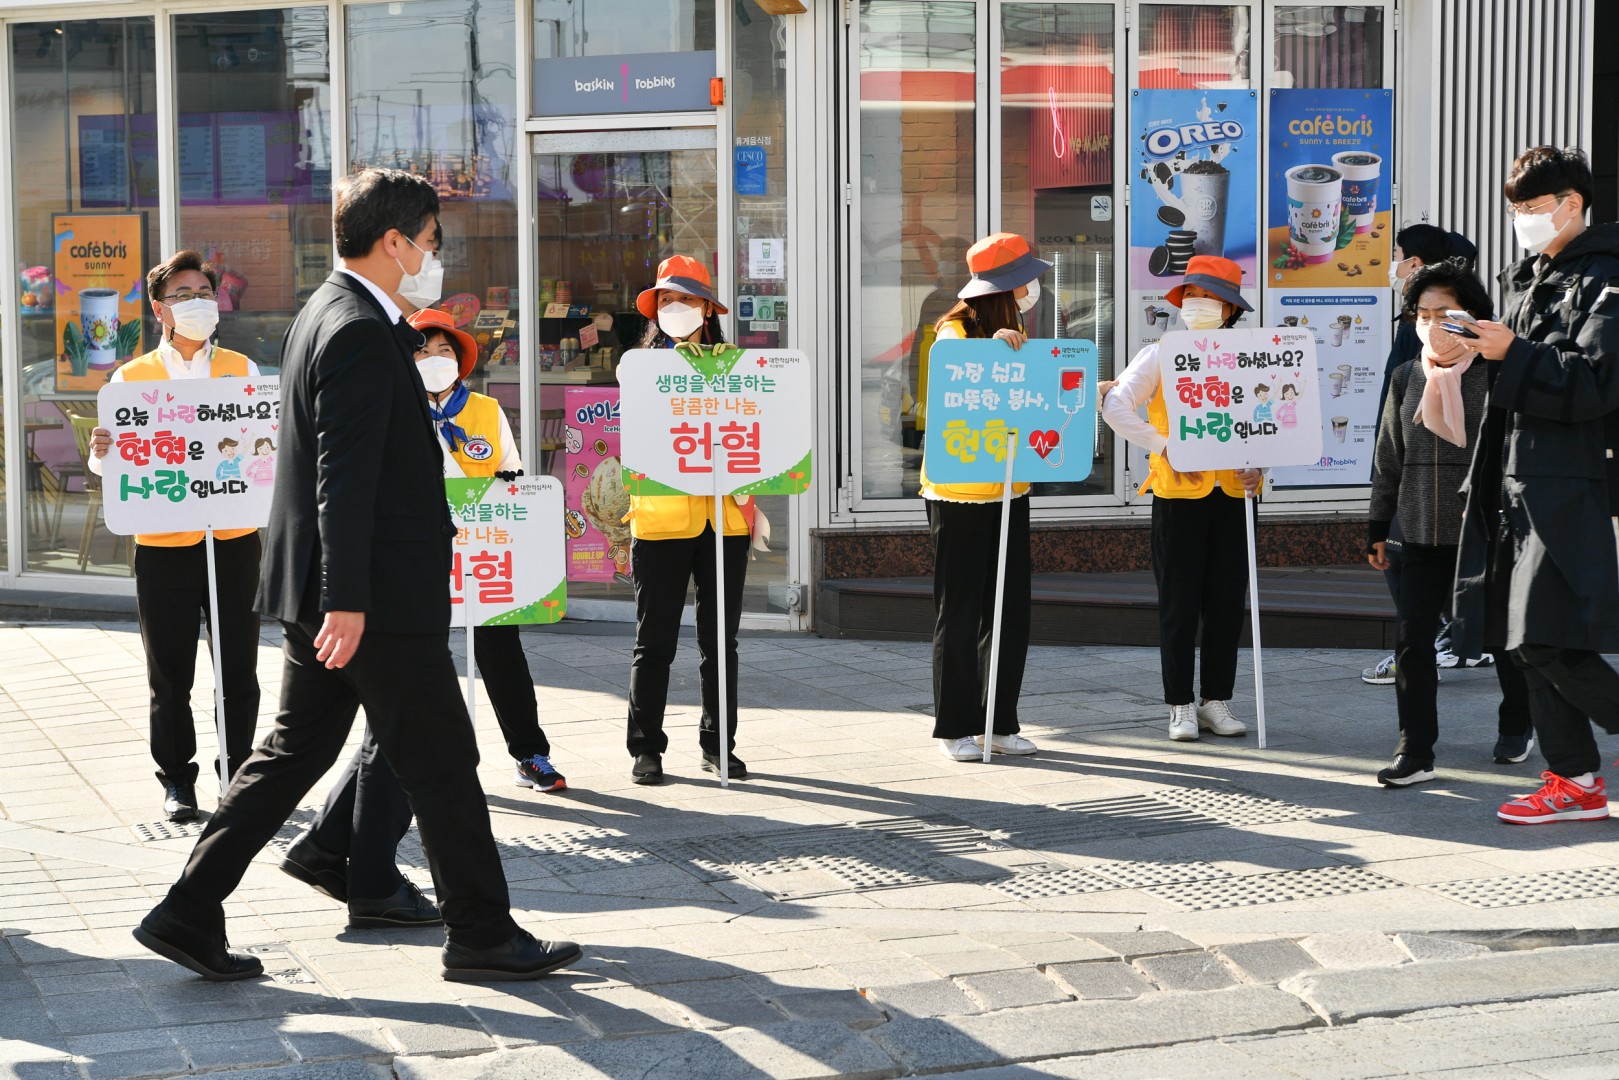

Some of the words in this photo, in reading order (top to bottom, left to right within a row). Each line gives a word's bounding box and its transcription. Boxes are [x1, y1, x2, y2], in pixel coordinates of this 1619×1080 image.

[574, 77, 615, 92] baskin
[635, 76, 676, 90] robbins
[1337, 114, 1373, 137] bris
[736, 136, 772, 146] 휴게음식점
[1147, 121, 1242, 155] OREO
[737, 151, 763, 162] CESCO
[103, 240, 127, 259] bris
[84, 261, 112, 270] SUNNY
[1282, 334, 1307, 342] 대한적십자사
[768, 356, 800, 364] 대한적십자사
[1174, 353, 1201, 372] 오늘
[1206, 350, 1304, 370] 사랑하셨나요?
[944, 361, 985, 384] 가장
[991, 361, 1026, 384] 쉽고
[256, 384, 281, 392] 대한적십
[655, 374, 706, 394] 생명을
[709, 374, 777, 394] 선물하는
[1175, 375, 1245, 409] 헌혈은
[670, 397, 720, 416] 달콤한
[724, 397, 763, 416] 나눔,
[943, 388, 1001, 412] 따뜻한
[1007, 388, 1050, 412] 봉사,
[114, 406, 150, 427] 오늘
[157, 400, 281, 424] 사랑하셨나요?
[1179, 411, 1279, 443] 사랑입니다
[115, 430, 205, 466] 헌혈은
[670, 420, 762, 474] 헌혈
[942, 419, 1019, 464] 헌혈
[1334, 458, 1358, 466] robbins
[120, 469, 249, 503] 사랑입니다
[520, 484, 553, 492] 대한적십자사
[460, 502, 529, 523] 선물하는
[475, 526, 516, 545] 나눔,
[572, 551, 595, 560] DOUBLE
[595, 551, 605, 560] UP
